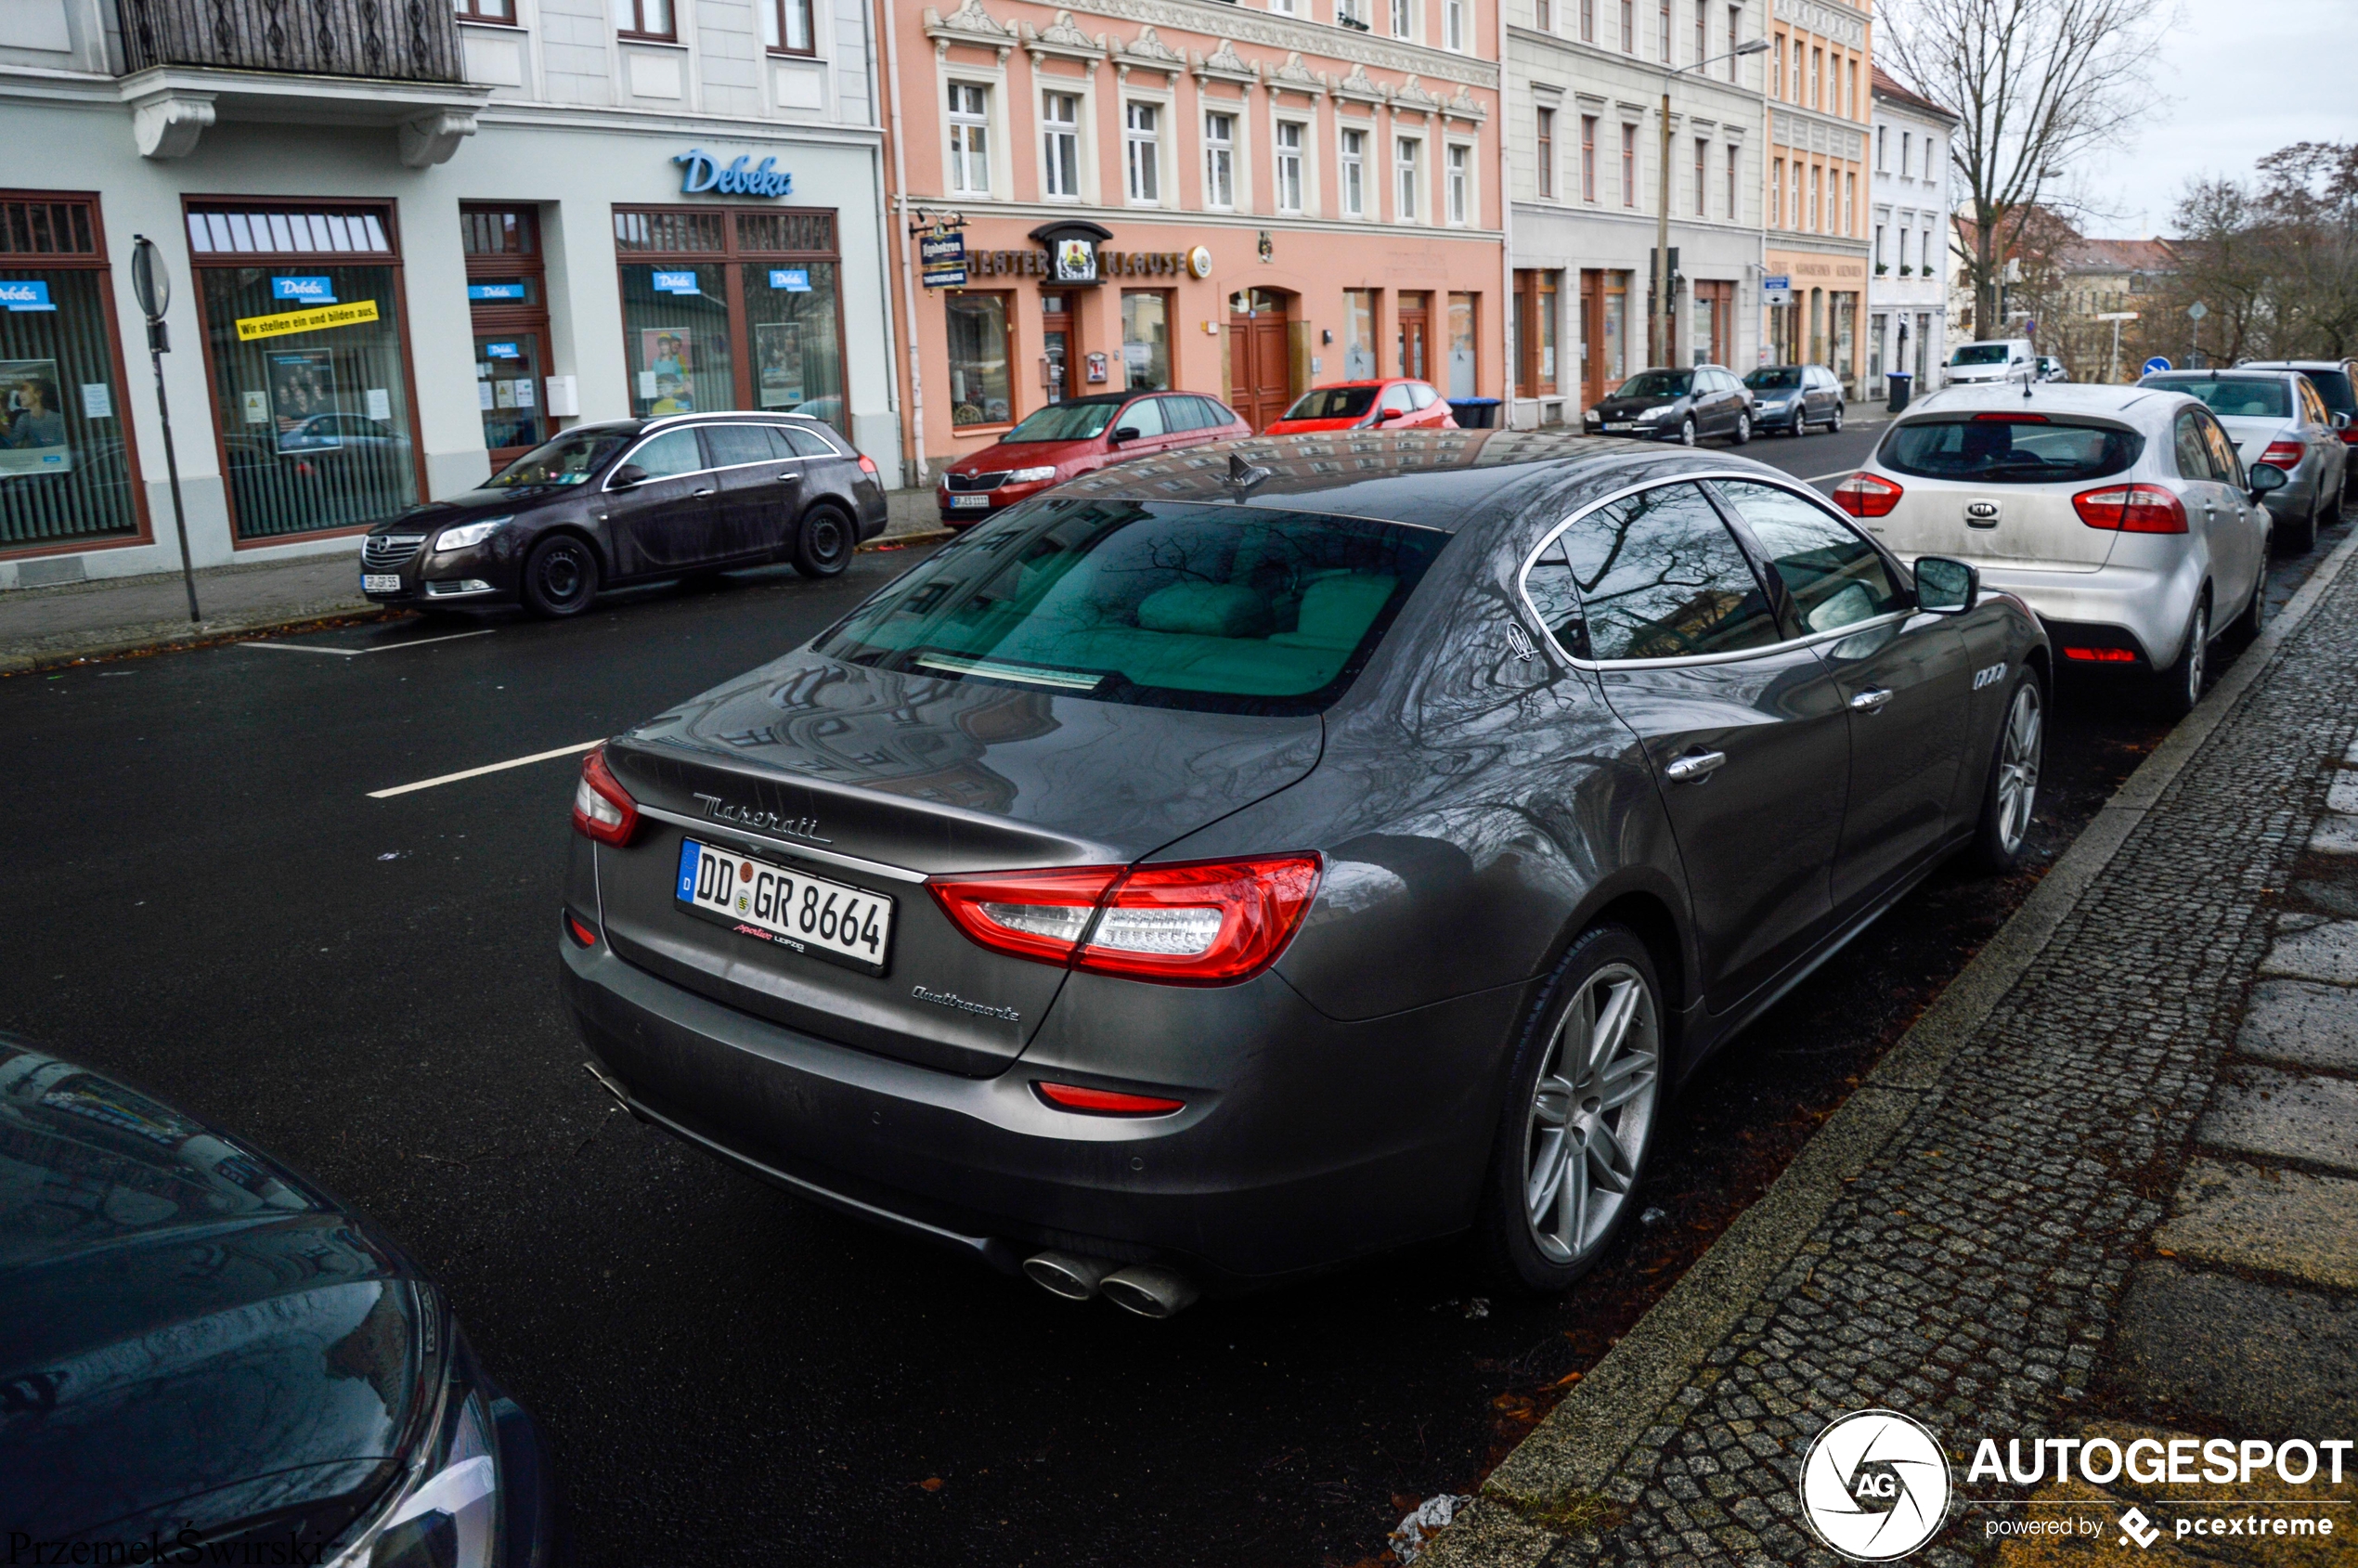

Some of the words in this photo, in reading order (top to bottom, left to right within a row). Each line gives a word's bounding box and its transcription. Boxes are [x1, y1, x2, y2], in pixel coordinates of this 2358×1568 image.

[672, 148, 794, 198] Debeka
[965, 249, 1051, 277] HEATER
[1103, 251, 1186, 275] KLAUSE
[280, 279, 324, 294] Debeka
[240, 324, 257, 335] Wir
[260, 319, 291, 332] stellen
[293, 316, 307, 327] ein
[309, 313, 327, 325] und
[329, 309, 356, 322] bilden
[357, 306, 376, 318] aus.
[1970, 504, 1993, 514] KIA
[693, 792, 833, 845] Maserati
[682, 876, 692, 891] D
[696, 852, 734, 907] DD
[754, 871, 794, 927] GR
[799, 885, 880, 954] 8664
[773, 935, 805, 951] LEIPZIG
[911, 985, 1020, 1022] Quattroporte
